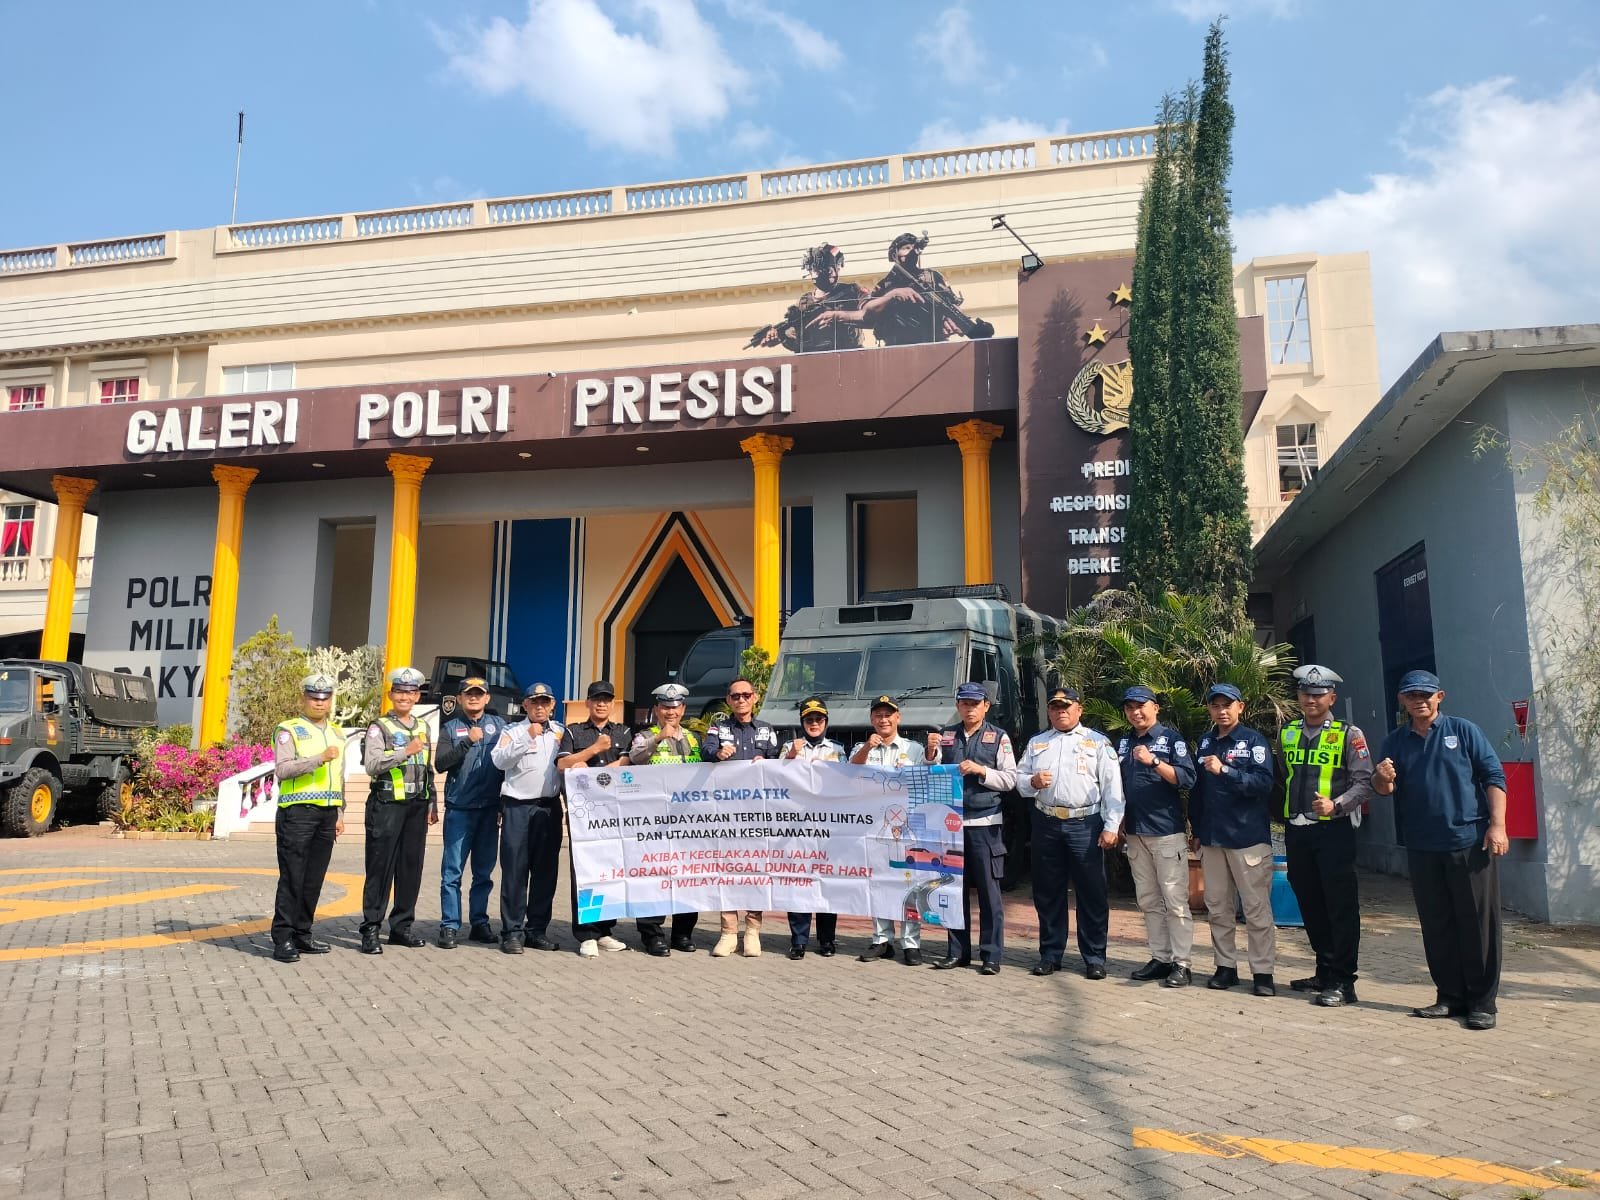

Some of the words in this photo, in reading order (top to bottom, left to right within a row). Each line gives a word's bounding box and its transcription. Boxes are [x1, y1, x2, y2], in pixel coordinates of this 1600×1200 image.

[126, 398, 298, 455] GALERI
[357, 385, 510, 441] POLRI
[574, 363, 793, 427] PRESISI
[1083, 459, 1130, 478] PREDI
[1068, 556, 1121, 575] BERKE
[129, 618, 209, 651] MILIK
[671, 790, 709, 803] AKSI
[713, 788, 790, 802] SIMPATIK
[588, 818, 620, 830] MARI
[623, 816, 651, 827] KITA
[654, 813, 730, 826] BUDAYAKAN
[733, 812, 773, 822] TERTIB
[776, 812, 827, 822] BERLALU
[830, 813, 873, 825] LINTAS
[637, 831, 663, 842] DAN
[665, 828, 737, 840] UTAMAKAN
[740, 827, 830, 839] KESELAMATAN
[641, 851, 687, 863] AKIBAT
[689, 850, 769, 860] KECELAKAAN
[771, 849, 784, 859] DI
[787, 850, 829, 862] JALAN,
[611, 869, 625, 880] 14
[628, 865, 678, 877] ORANG
[682, 863, 761, 875] MENINGGAL
[764, 863, 807, 873] DUNIA
[811, 864, 834, 875] PER
[838, 866, 873, 877] HARI
[661, 879, 673, 889] DI
[677, 877, 735, 888] WILAYAH
[738, 877, 774, 886] JAWA
[779, 877, 813, 887] TIMUR
